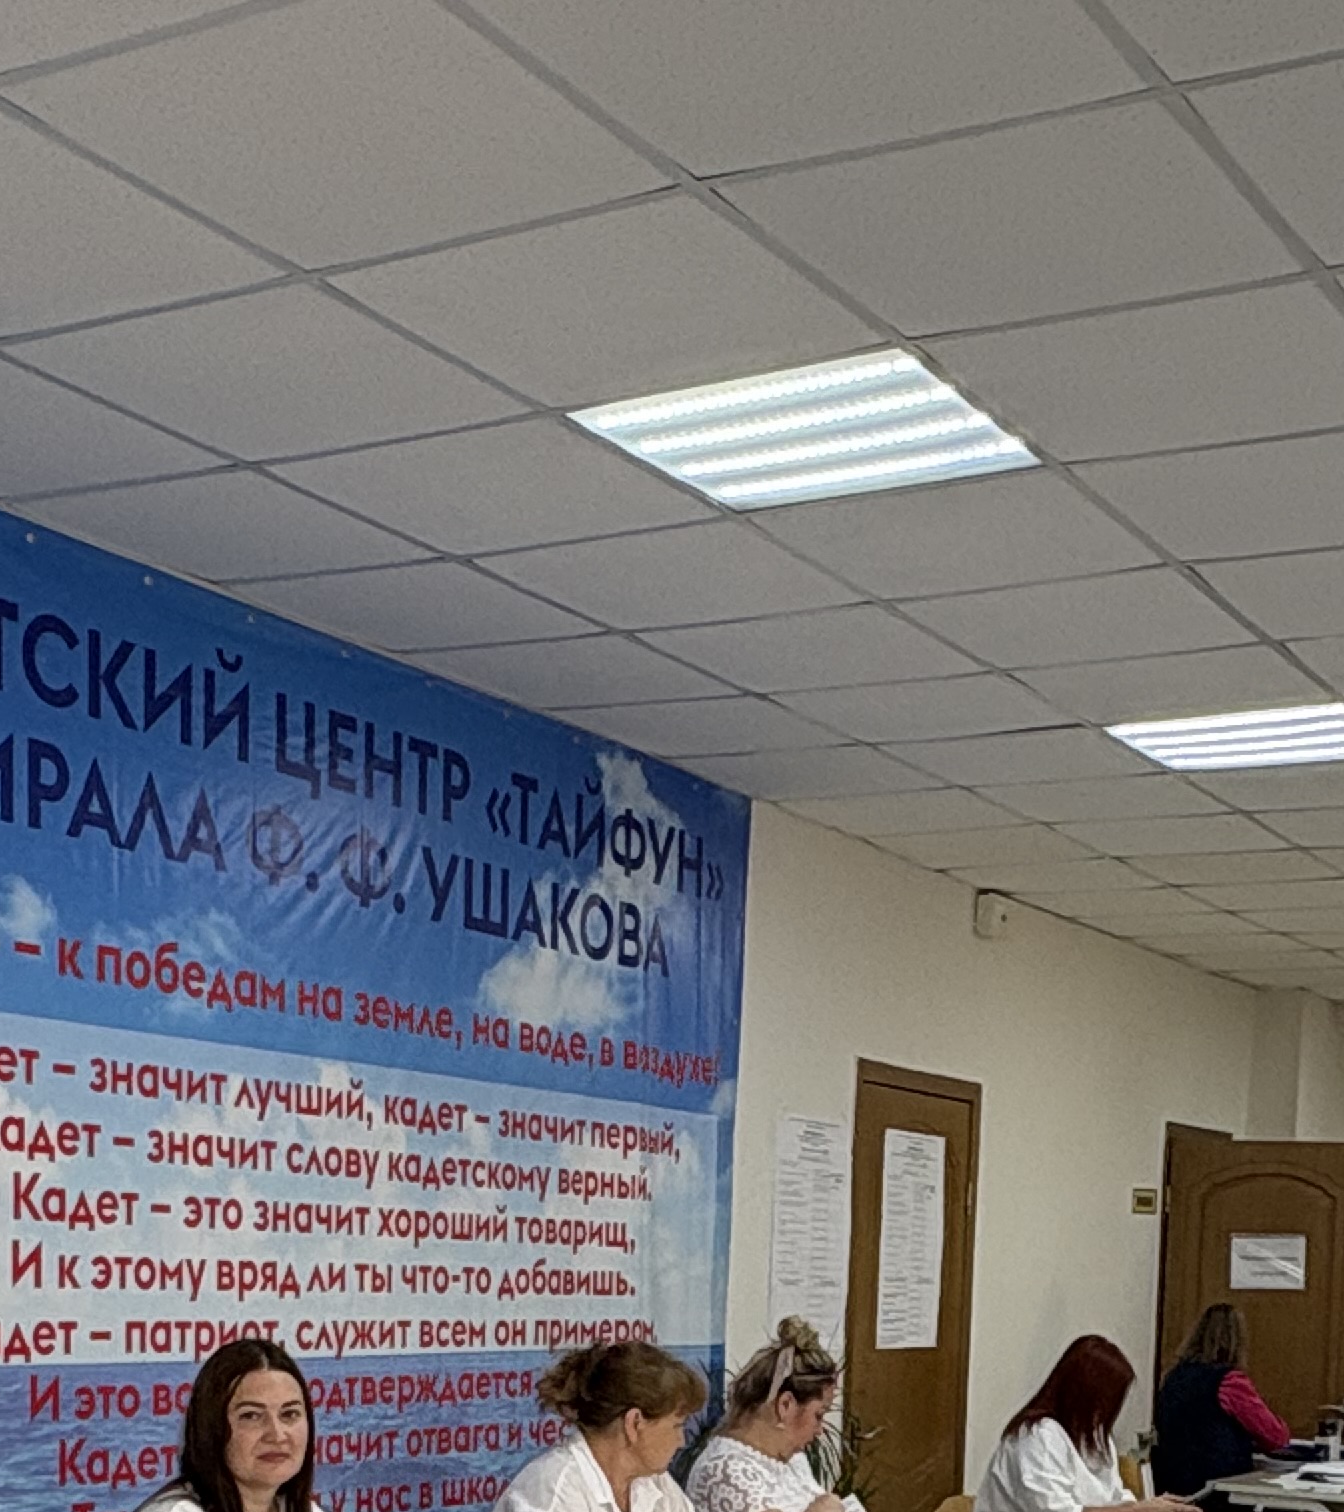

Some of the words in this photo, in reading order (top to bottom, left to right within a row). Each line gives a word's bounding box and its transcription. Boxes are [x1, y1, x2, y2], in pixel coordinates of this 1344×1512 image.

[274, 691, 471, 822] ЦЕНТР
[486, 771, 725, 900] «ТАЙФУН»
[421, 844, 670, 978] УШАКОВА
[57, 936, 83, 981] к
[96, 938, 285, 1013] победам
[297, 979, 344, 1021] на
[353, 991, 463, 1051] земле,
[471, 1012, 510, 1050] на
[518, 1021, 594, 1069] воде,
[599, 1037, 616, 1068] в
[89, 1057, 228, 1107] значит
[234, 1076, 374, 1130] лучший,
[384, 1093, 468, 1135] кадет
[497, 1108, 586, 1146] значит
[589, 1118, 681, 1163] первый,
[146, 1129, 278, 1172] значит
[285, 1141, 380, 1189] слову
[387, 1150, 552, 1202] кадетскому
[11, 1171, 140, 1232] Кадет
[182, 1195, 244, 1231] это
[252, 1201, 370, 1237] значит
[376, 1204, 509, 1248] хороший
[515, 1214, 636, 1255] товарищ,
[10, 1238, 44, 1290] И
[57, 1254, 82, 1290] к
[90, 1254, 207, 1302] этому
[216, 1258, 301, 1302] вряд
[306, 1263, 346, 1293] ли
[353, 1262, 394, 1294] ты
[400, 1262, 492, 1296] что-то
[497, 1257, 636, 1301] добавишь.
[295, 1318, 412, 1360] служит
[418, 1319, 486, 1349] всем
[494, 1319, 527, 1348] он
[28, 1374, 61, 1423] И
[73, 1383, 141, 1420] это
[58, 1437, 179, 1491] Кадет
[406, 1422, 500, 1458] отвага
[507, 1424, 523, 1449] и
[418, 1481, 434, 1509] в
